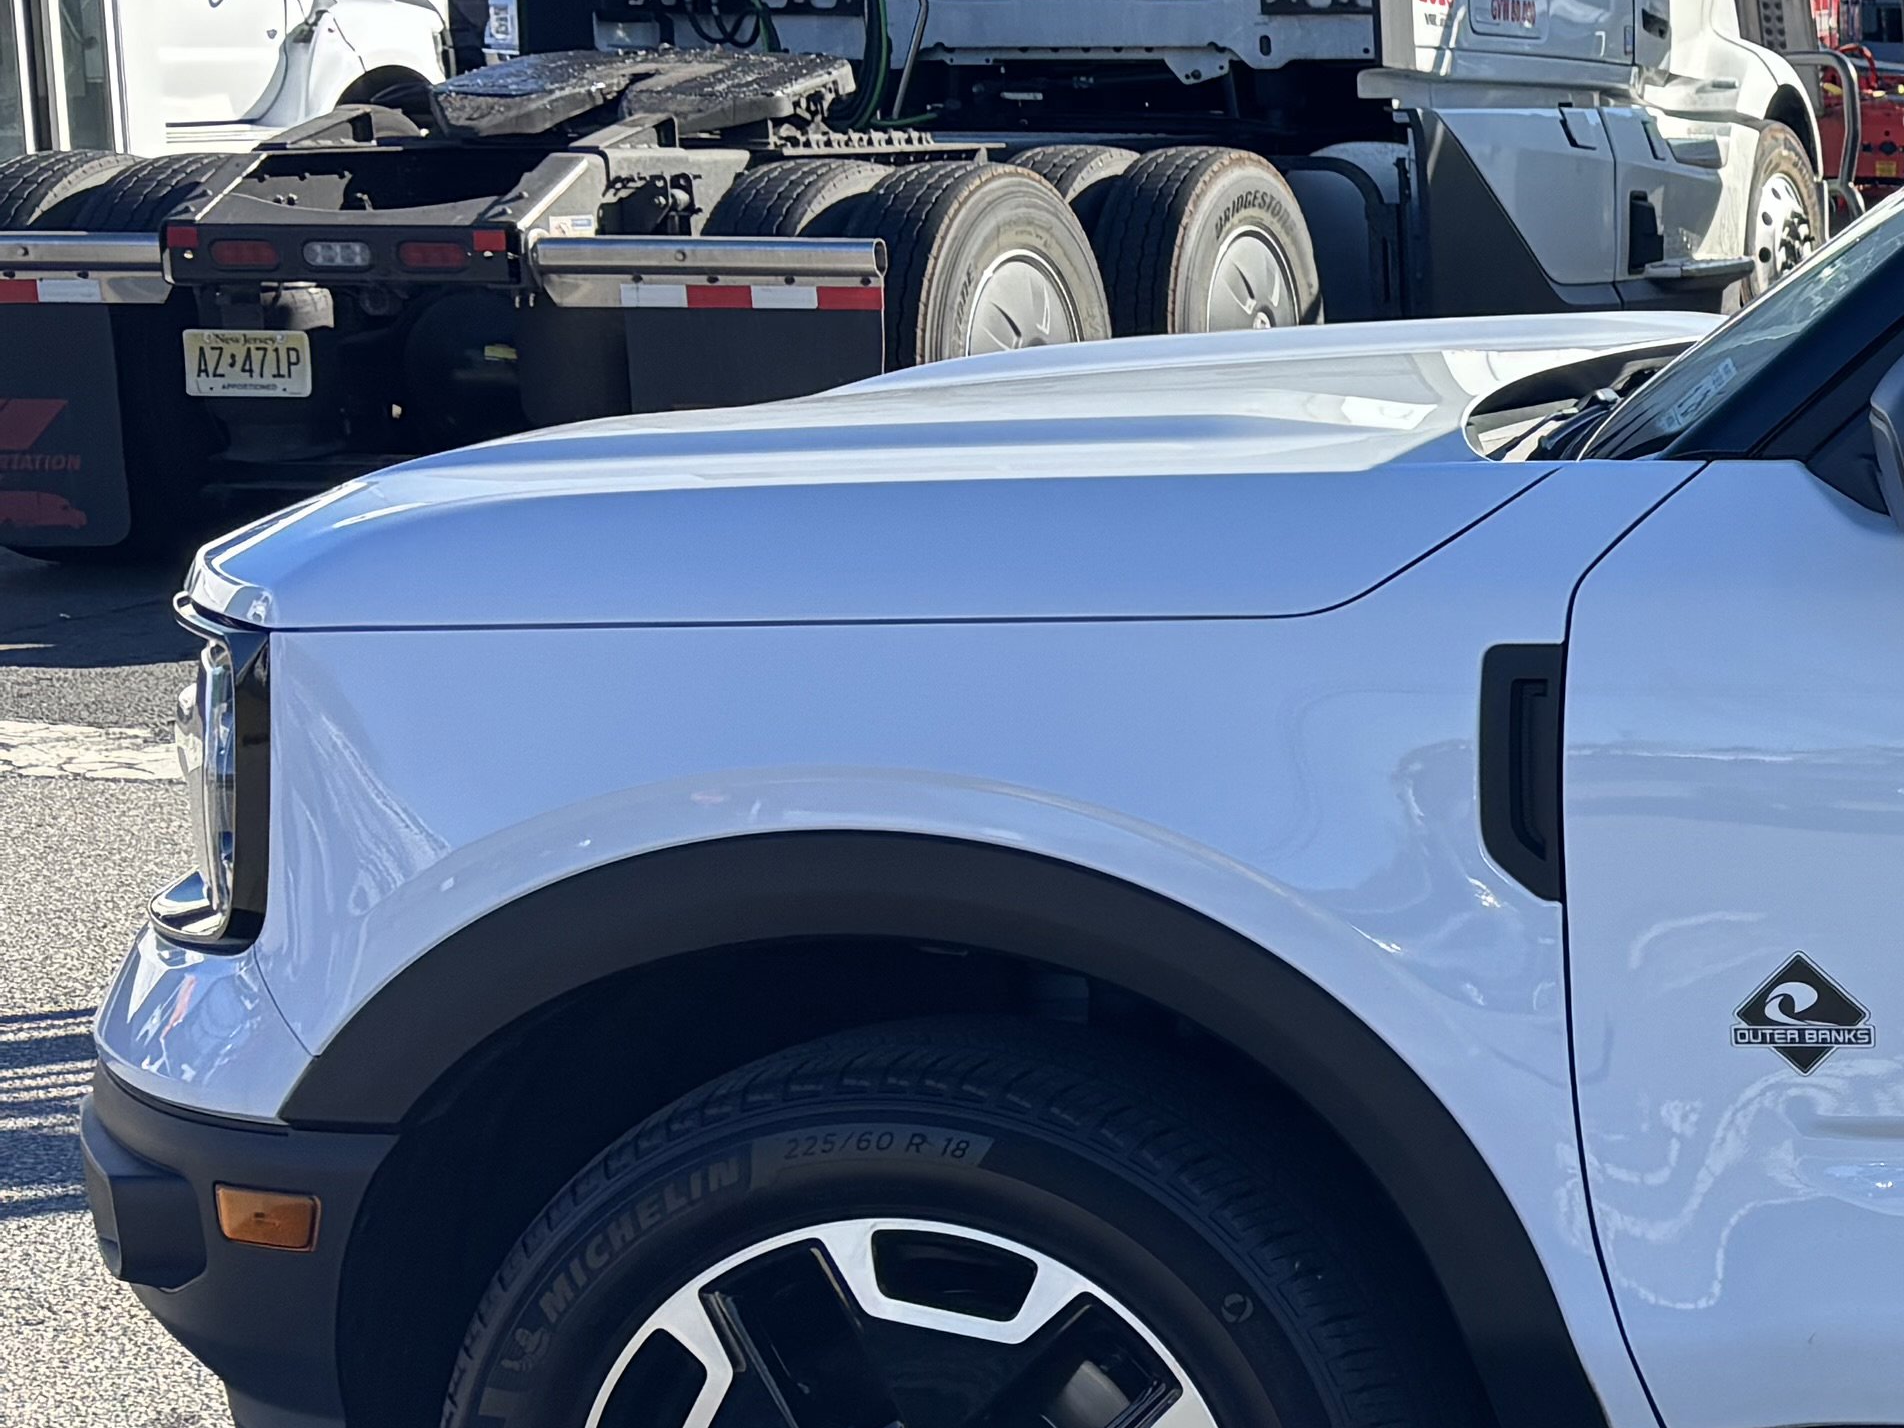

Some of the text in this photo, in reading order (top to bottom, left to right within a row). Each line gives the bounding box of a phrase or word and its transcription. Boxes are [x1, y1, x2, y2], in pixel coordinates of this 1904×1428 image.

[213, 333, 277, 346] New Jersey
[196, 346, 301, 379] AZ 471P
[1736, 1028, 1870, 1044] OUTER BANKS
[783, 1131, 895, 1161] 225/60
[940, 1136, 971, 1160] 18
[539, 1158, 741, 1322] MICHELIN
